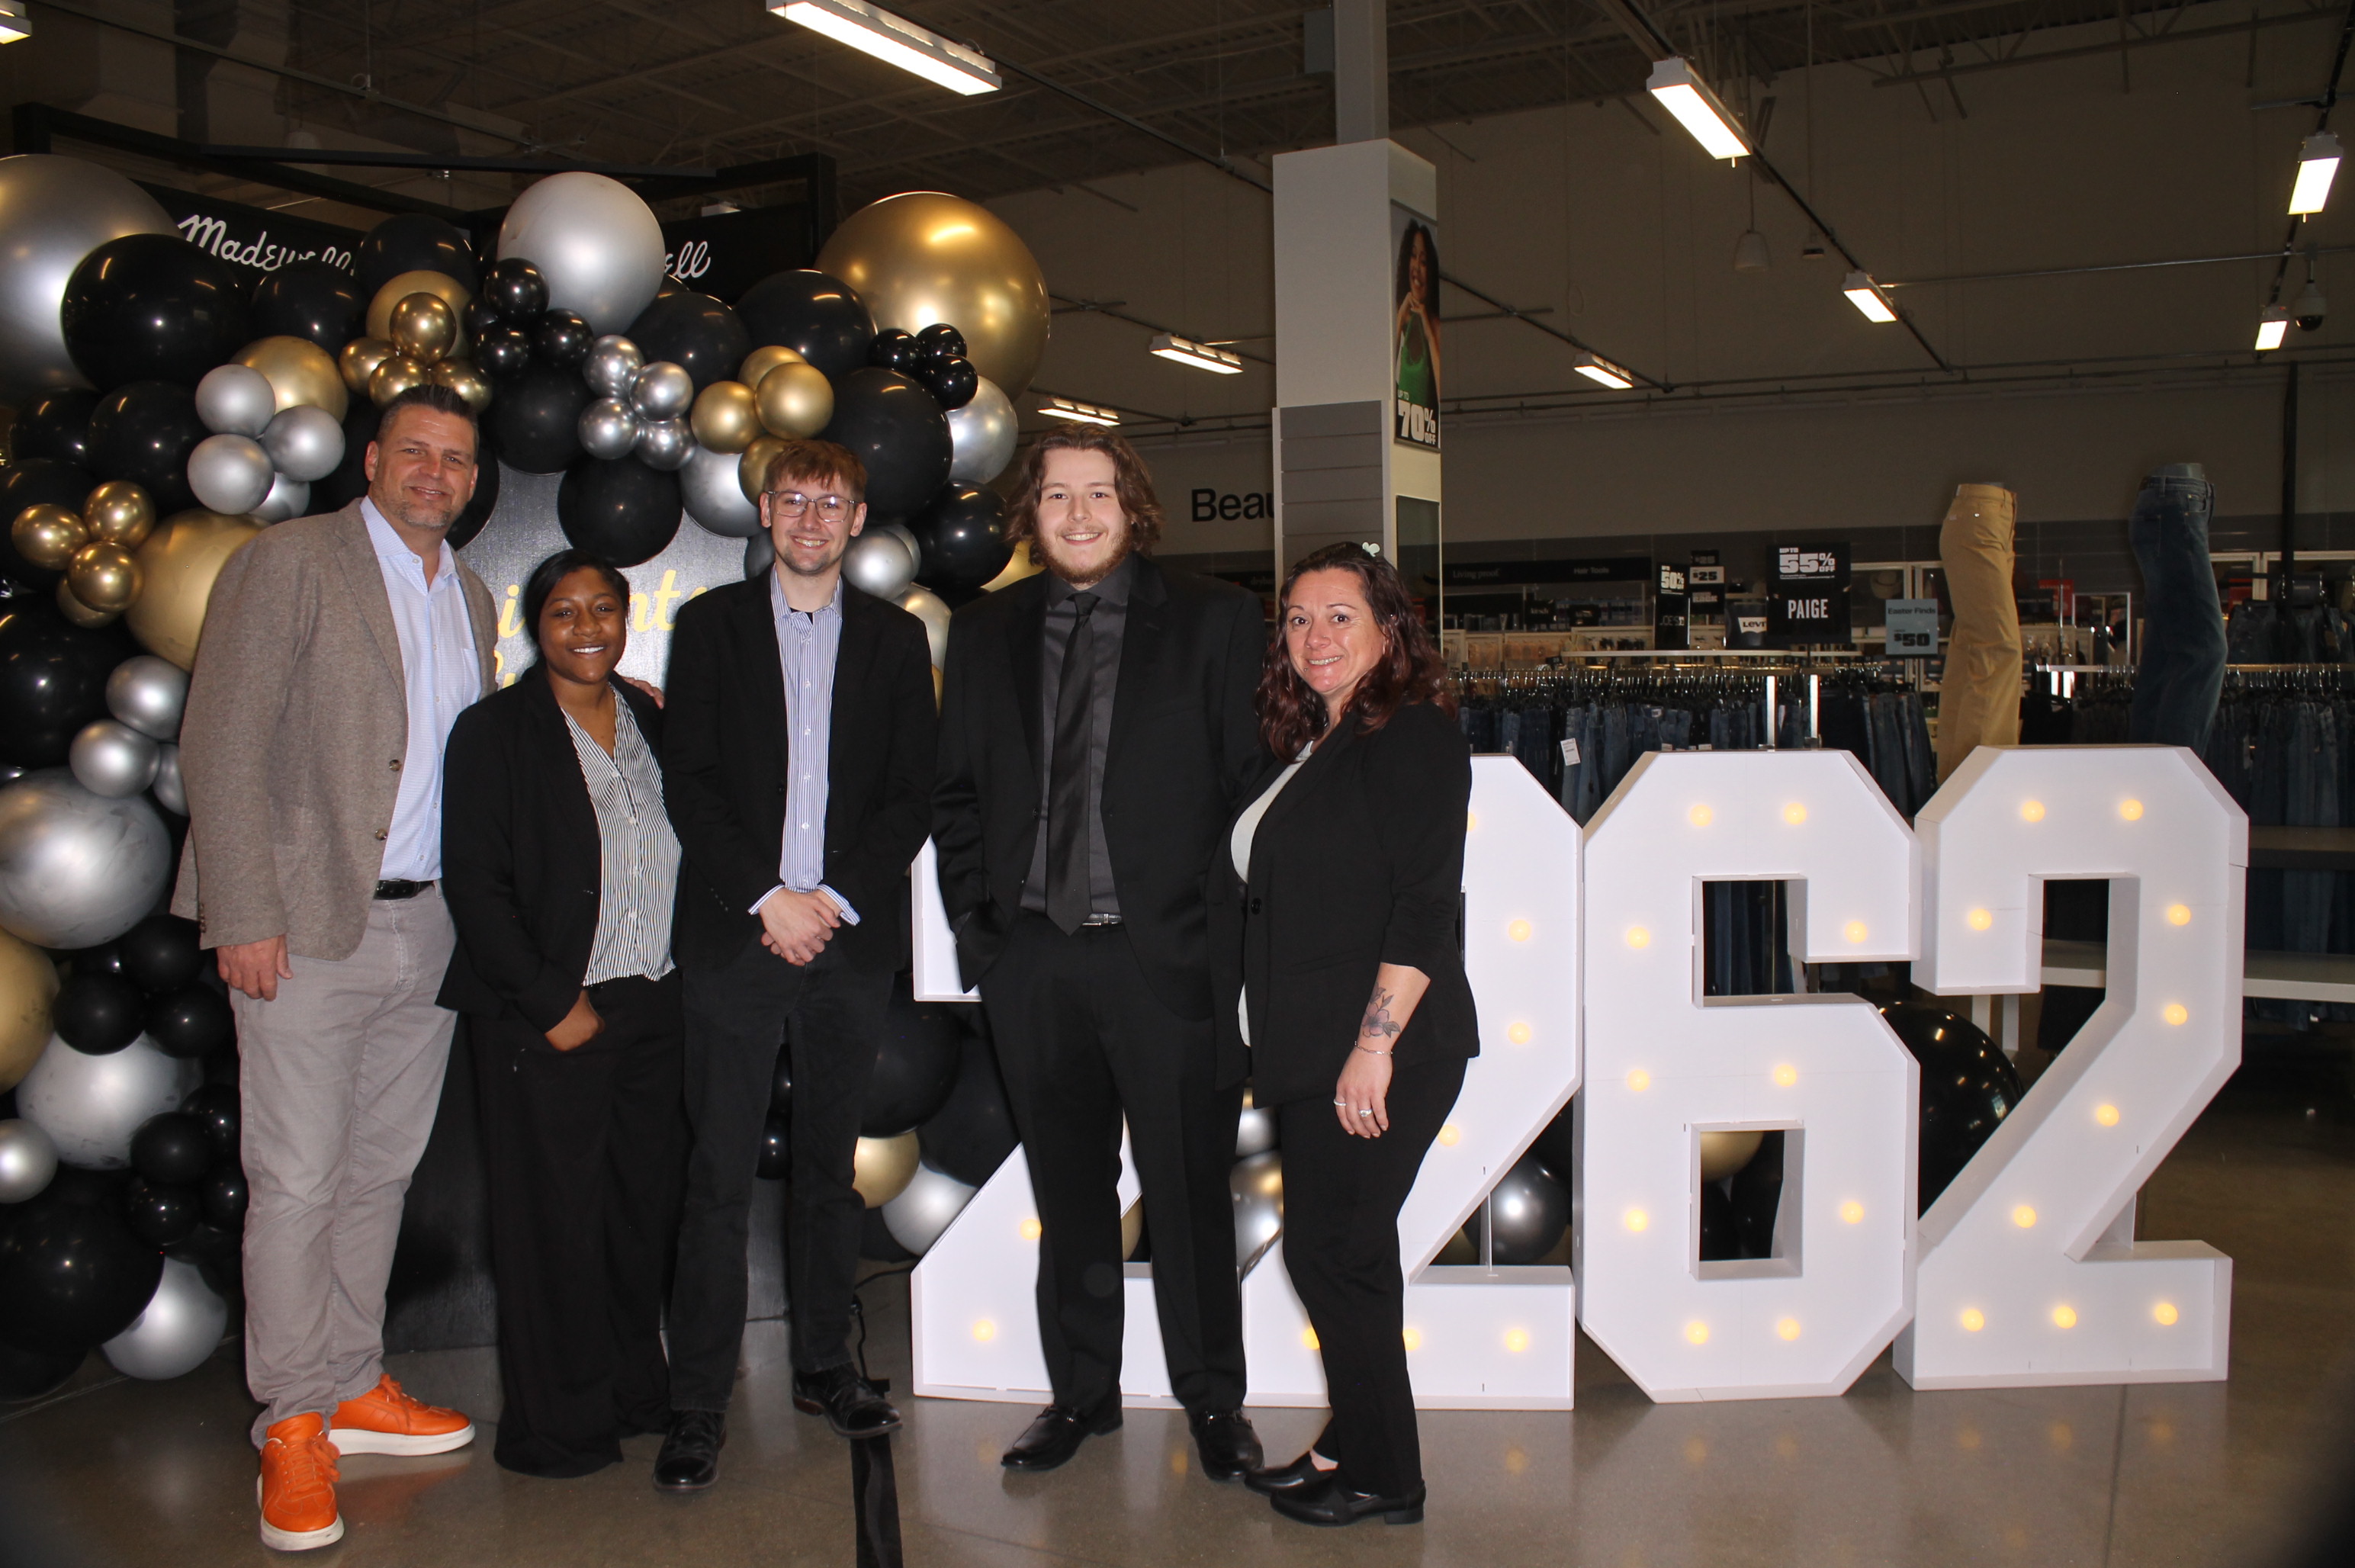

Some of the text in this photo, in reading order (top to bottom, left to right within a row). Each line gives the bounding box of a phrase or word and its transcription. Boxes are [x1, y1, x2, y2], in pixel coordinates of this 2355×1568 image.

[1398, 399, 1436, 442] 70%
[1779, 552, 1836, 574] 55%
[1788, 599, 1829, 619] PAIGE
[1894, 633, 1930, 647] $50
